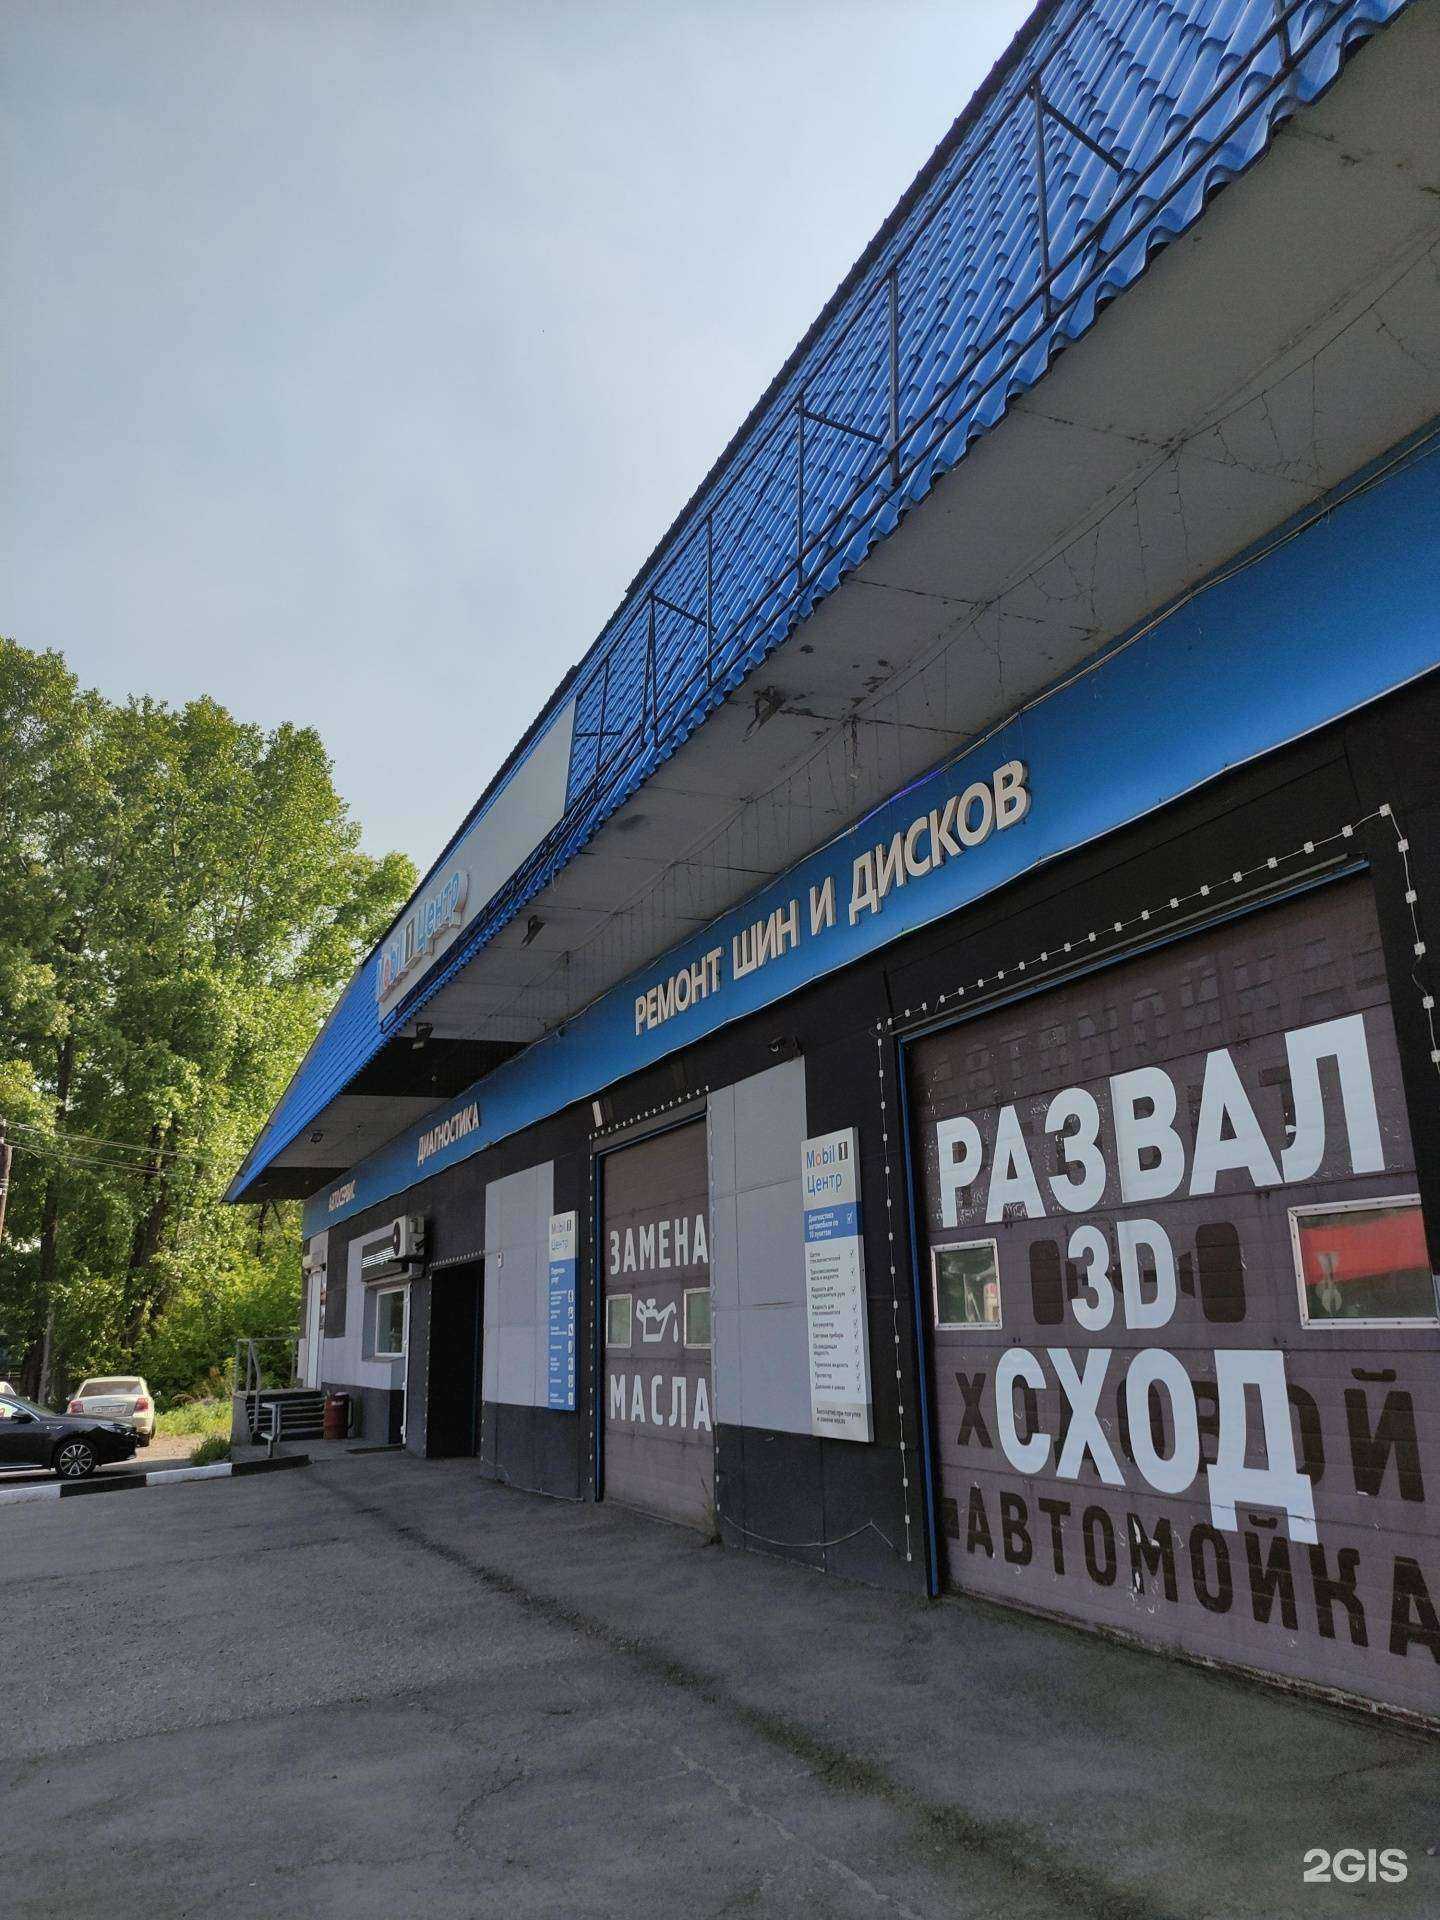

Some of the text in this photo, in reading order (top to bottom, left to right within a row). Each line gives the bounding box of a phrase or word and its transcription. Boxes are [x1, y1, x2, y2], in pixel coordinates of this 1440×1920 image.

[634, 759, 1032, 1036] РЕМОНТ ШИН И ДИСКОВ
[417, 1101, 481, 1168] ДИАГНОСТИКА
[806, 1141, 848, 1170] Mobil 1
[935, 1013, 1385, 1229] РАЗВАЛ
[807, 1172, 843, 1197] Центр
[610, 1214, 709, 1275] ЗАМЕНА
[1066, 1218, 1181, 1331] 3D
[610, 1374, 712, 1432] МАСЛА
[995, 1347, 1318, 1545] СХОД
[966, 1485, 1440, 1656] АВТОМОЙКА
